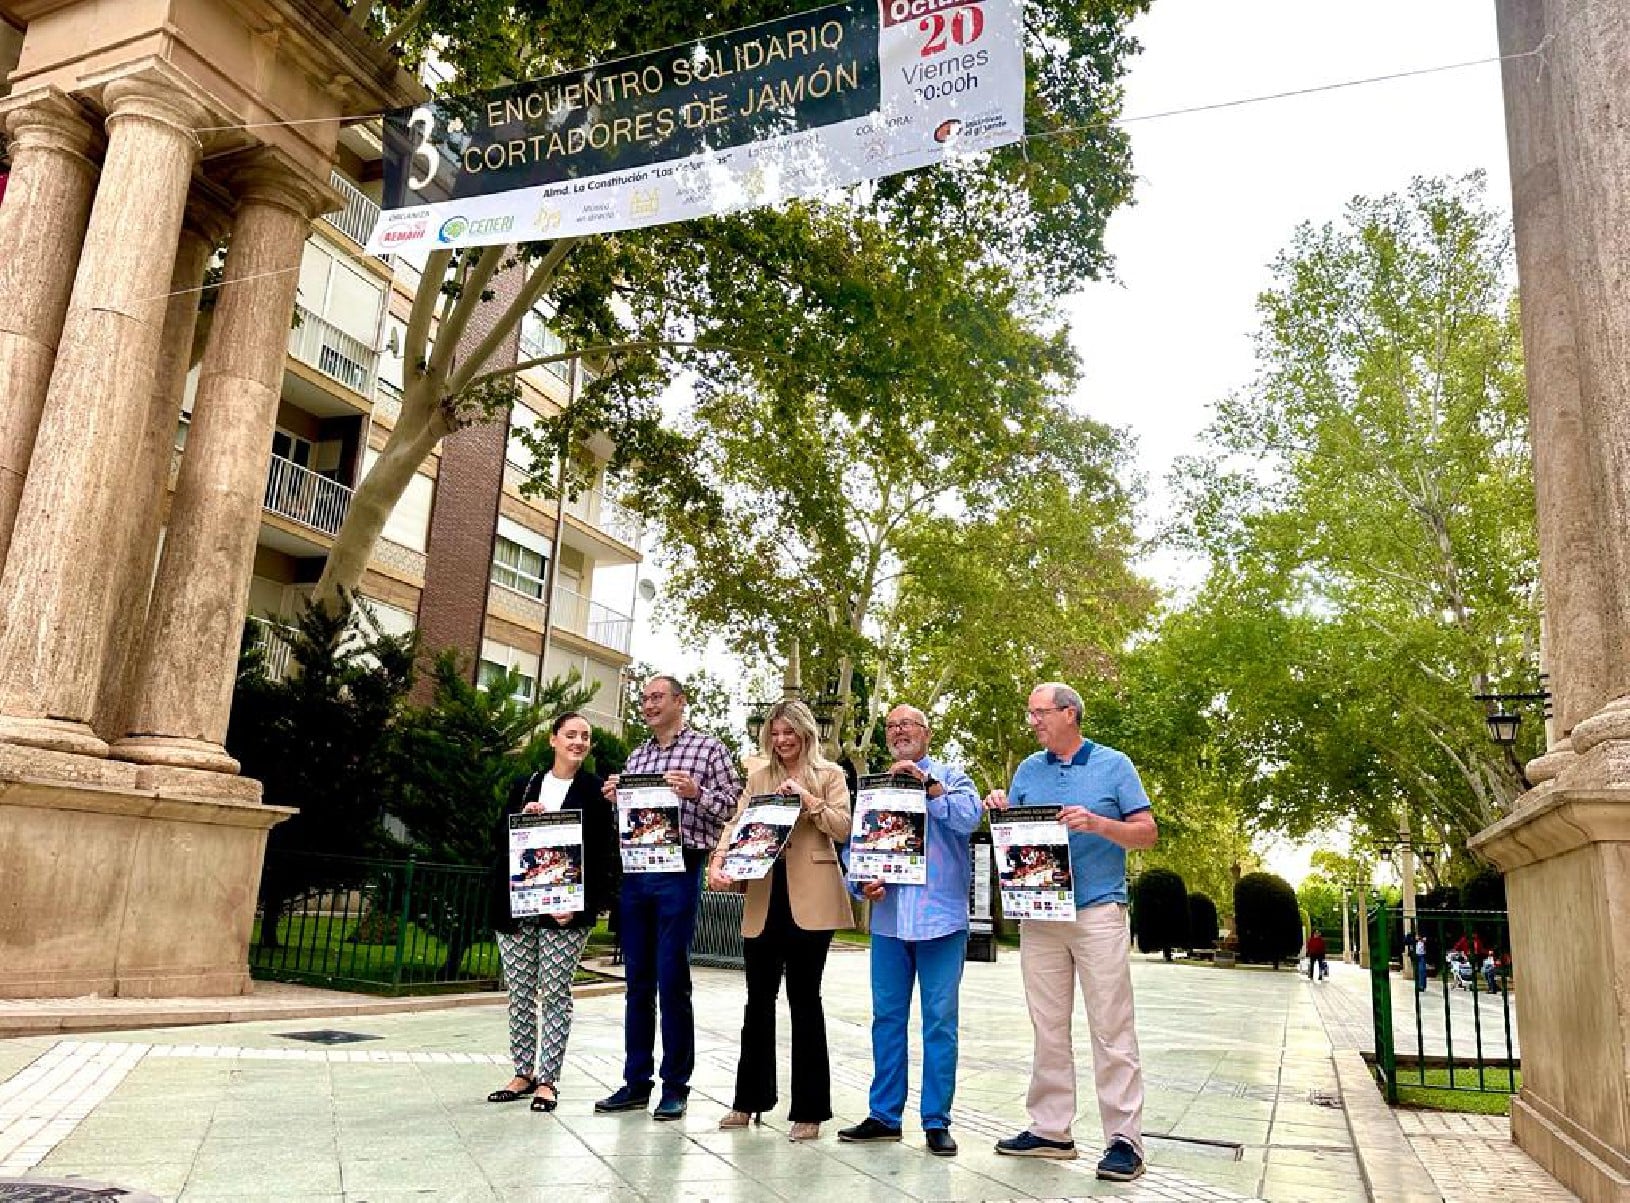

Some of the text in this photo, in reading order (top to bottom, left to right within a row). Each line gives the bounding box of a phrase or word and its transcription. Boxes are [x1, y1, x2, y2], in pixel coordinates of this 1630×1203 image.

[919, 5, 984, 57] 20
[487, 21, 844, 127] ENCUENTRO SOLIDARIO
[902, 49, 989, 85] Viernes
[407, 107, 440, 190] 3
[465, 60, 858, 173] CORTADORES DE JAMÓN
[543, 187, 570, 198] Almd.
[573, 184, 585, 193] La
[587, 171, 648, 191] Constitución
